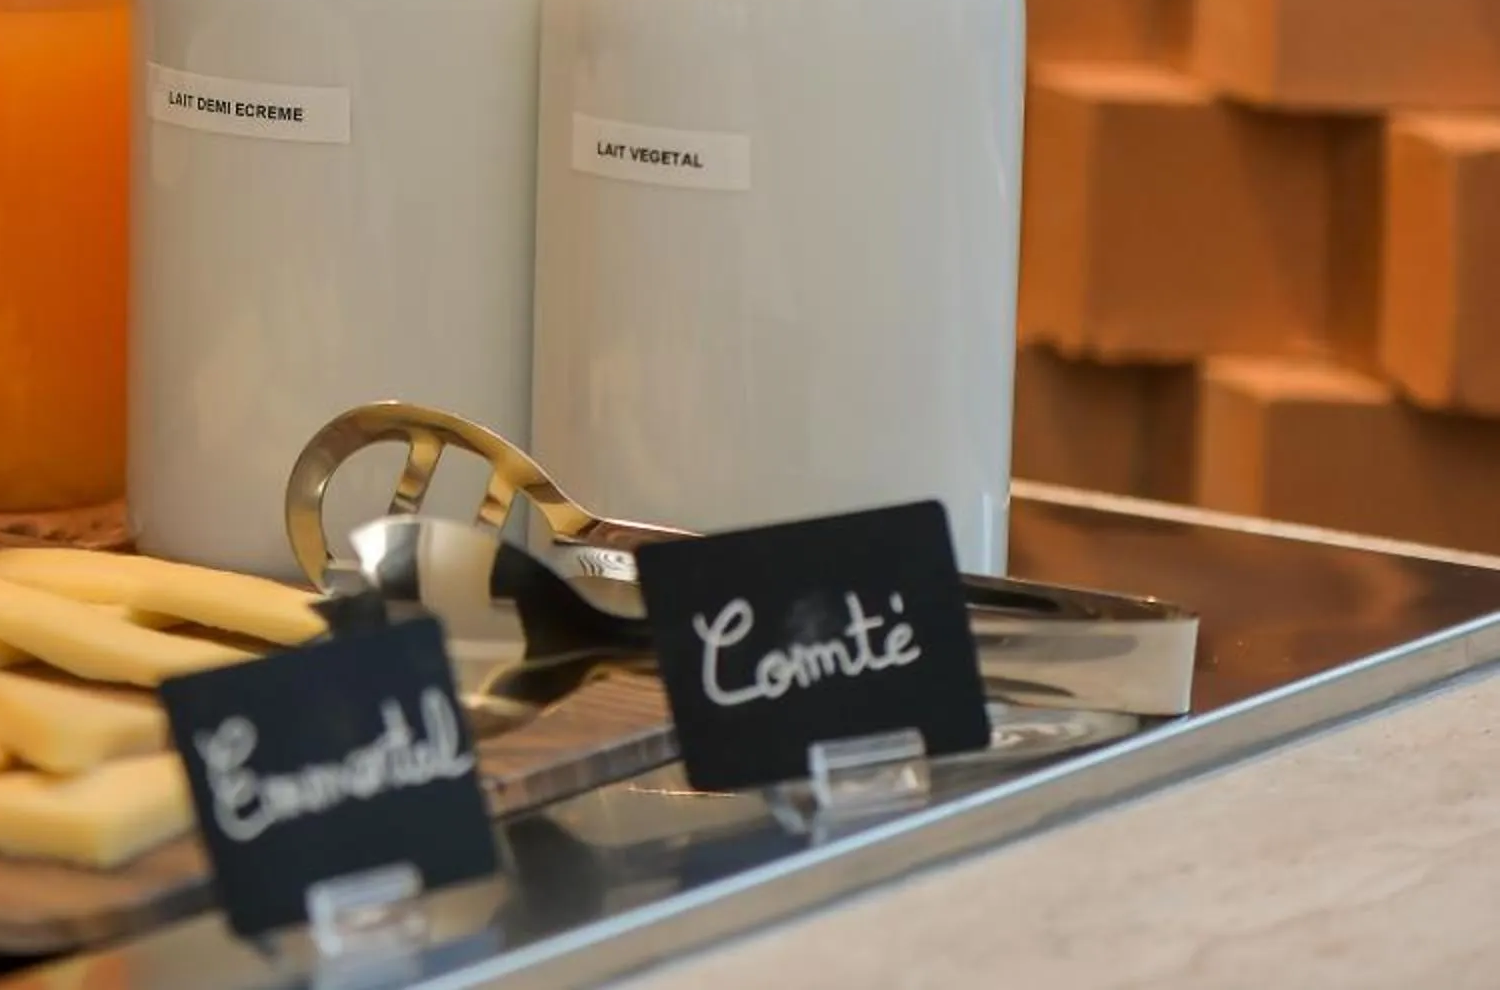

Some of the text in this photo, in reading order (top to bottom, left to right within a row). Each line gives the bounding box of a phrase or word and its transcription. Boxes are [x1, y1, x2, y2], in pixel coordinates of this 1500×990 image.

[168, 91, 304, 123] LAIT DEMI ECREME
[597, 141, 705, 169] LAIT VEGETAL
[692, 591, 921, 706] Comté
